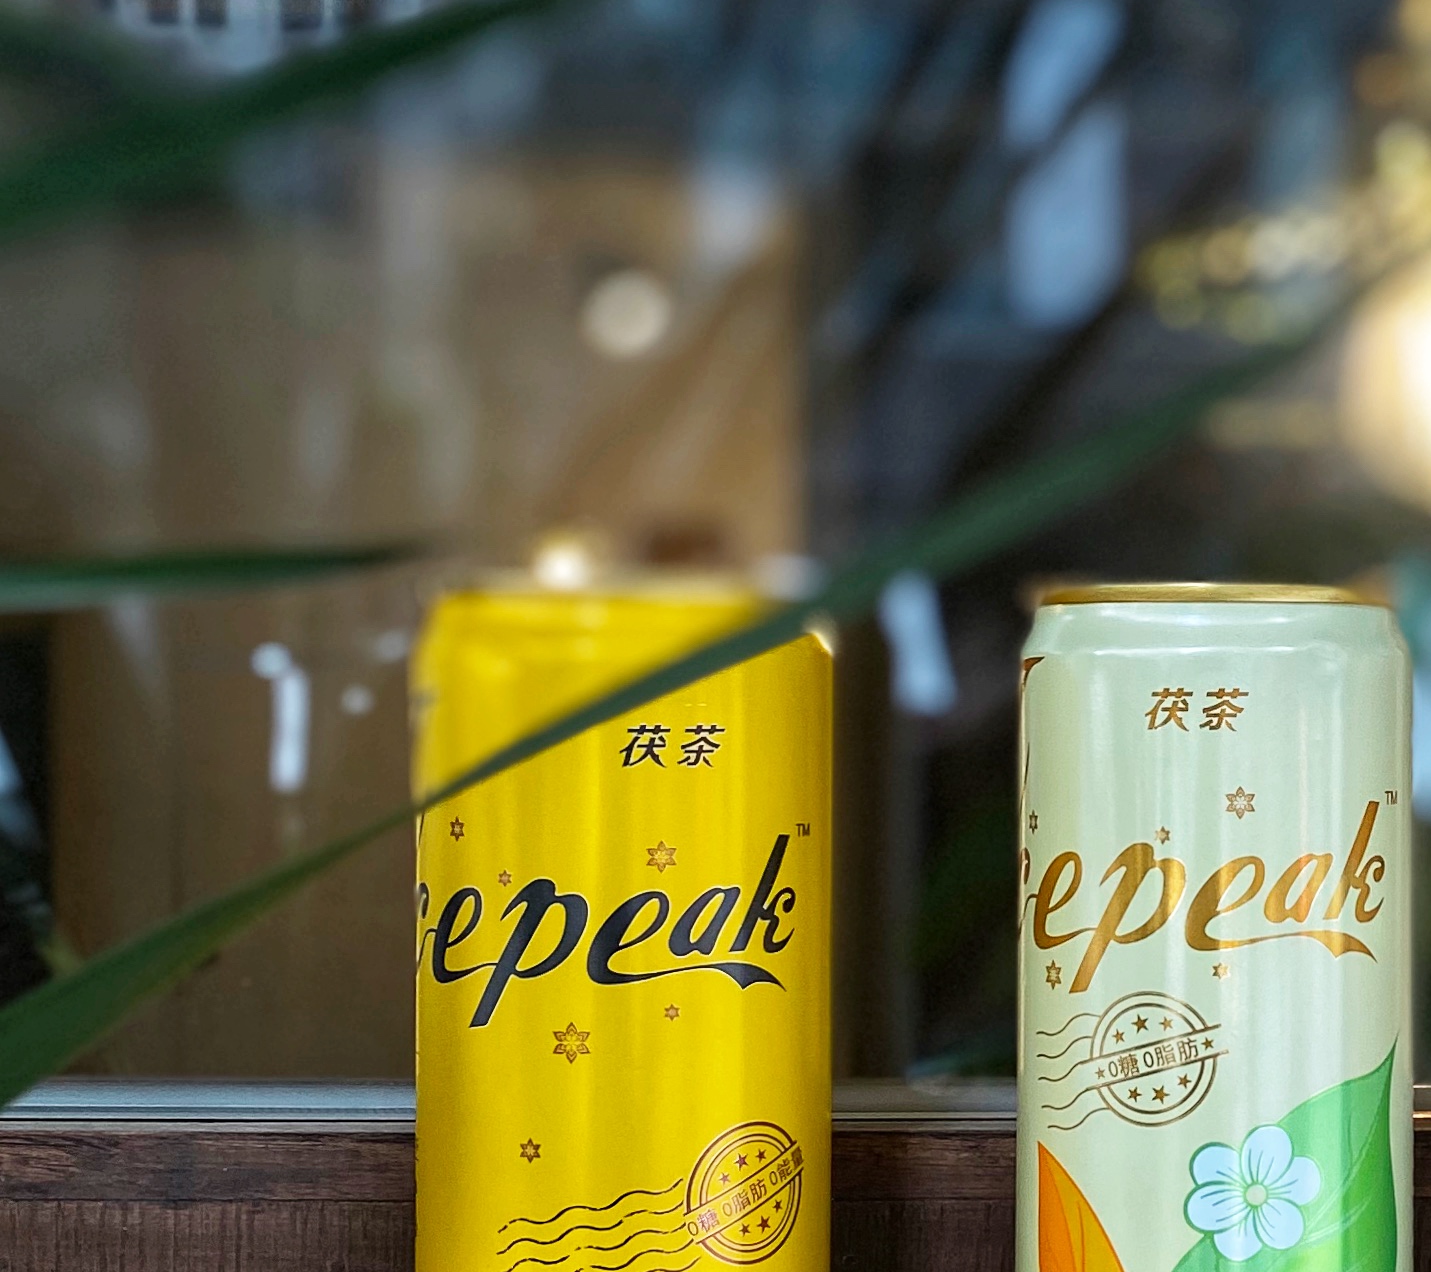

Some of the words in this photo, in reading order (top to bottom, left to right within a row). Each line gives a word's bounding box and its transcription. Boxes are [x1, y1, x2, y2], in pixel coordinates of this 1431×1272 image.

[1145, 687, 1249, 732] 茯茶
[619, 724, 726, 768] 茯茶
[1019, 800, 1386, 994] epeak
